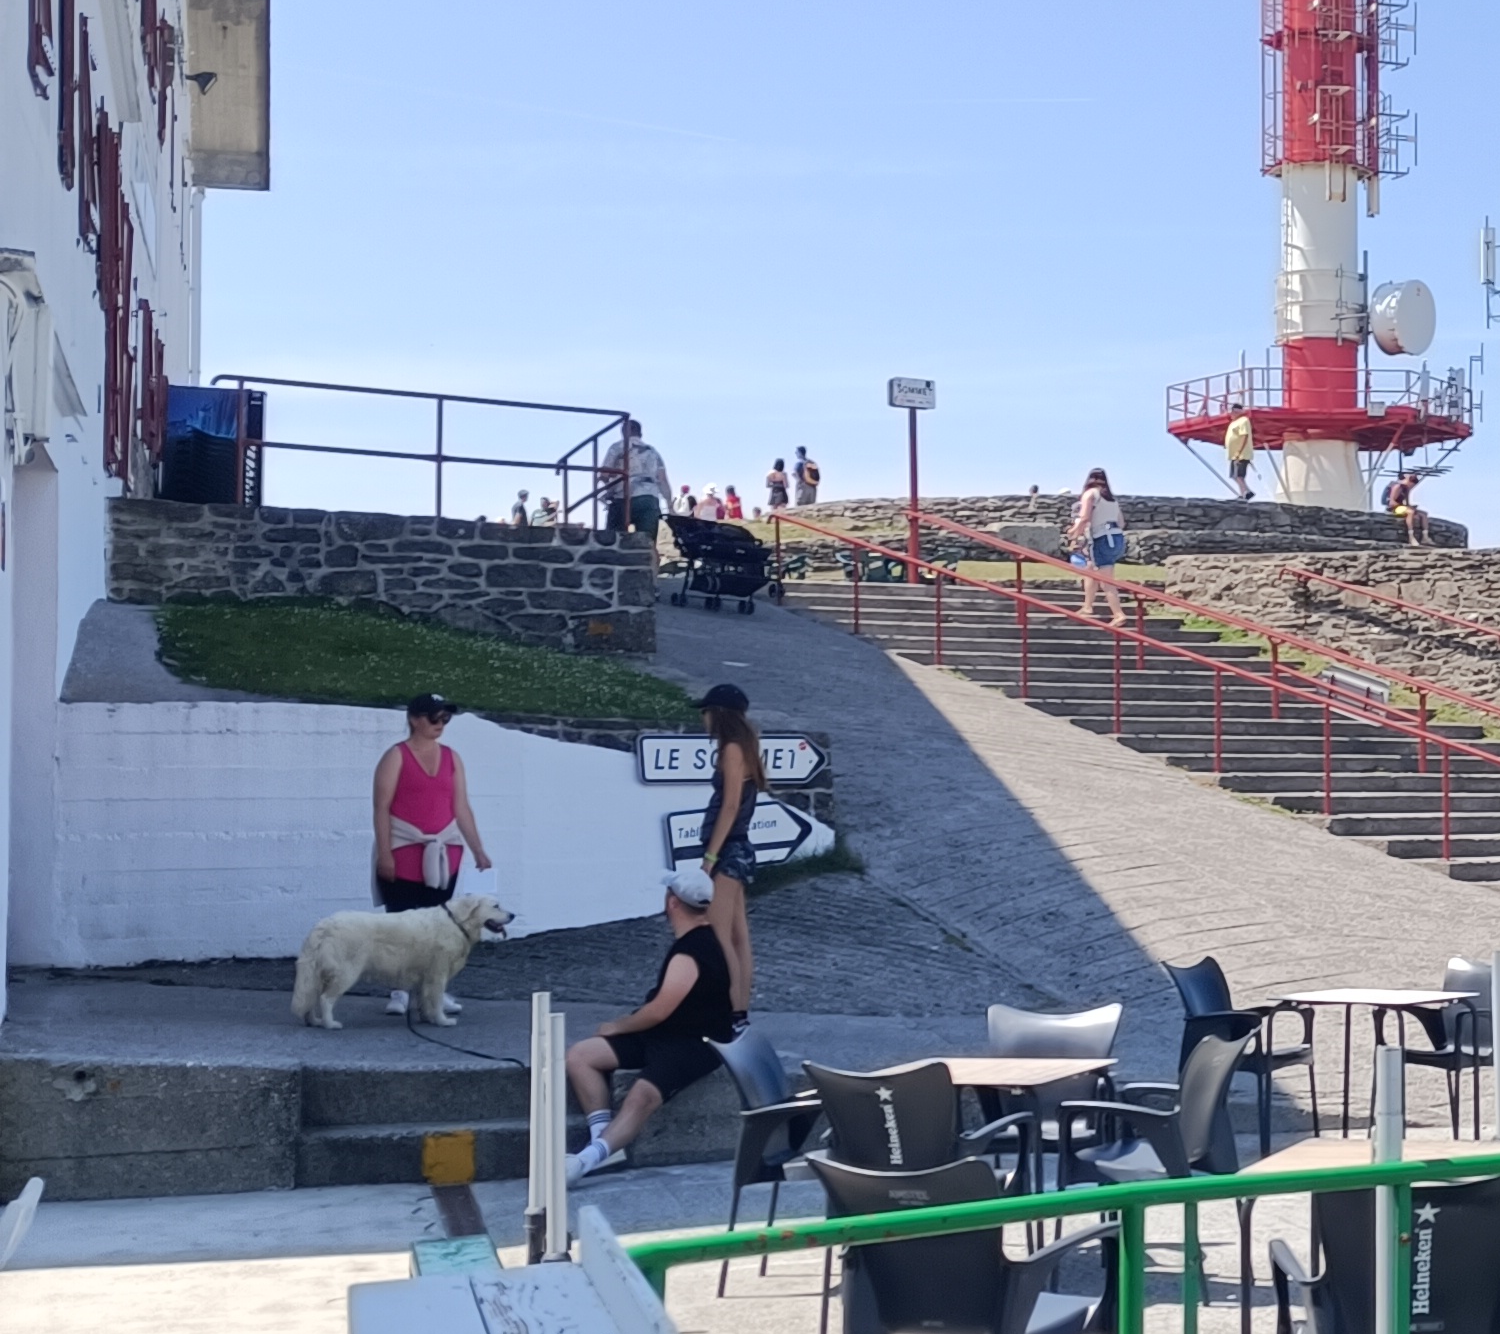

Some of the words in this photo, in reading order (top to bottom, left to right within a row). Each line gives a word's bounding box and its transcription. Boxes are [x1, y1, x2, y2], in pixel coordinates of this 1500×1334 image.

[654, 748, 680, 770] LE
[693, 748, 796, 770] SOET
[883, 1104, 903, 1165] Heineken
[1411, 1227, 1433, 1316] Heineken
